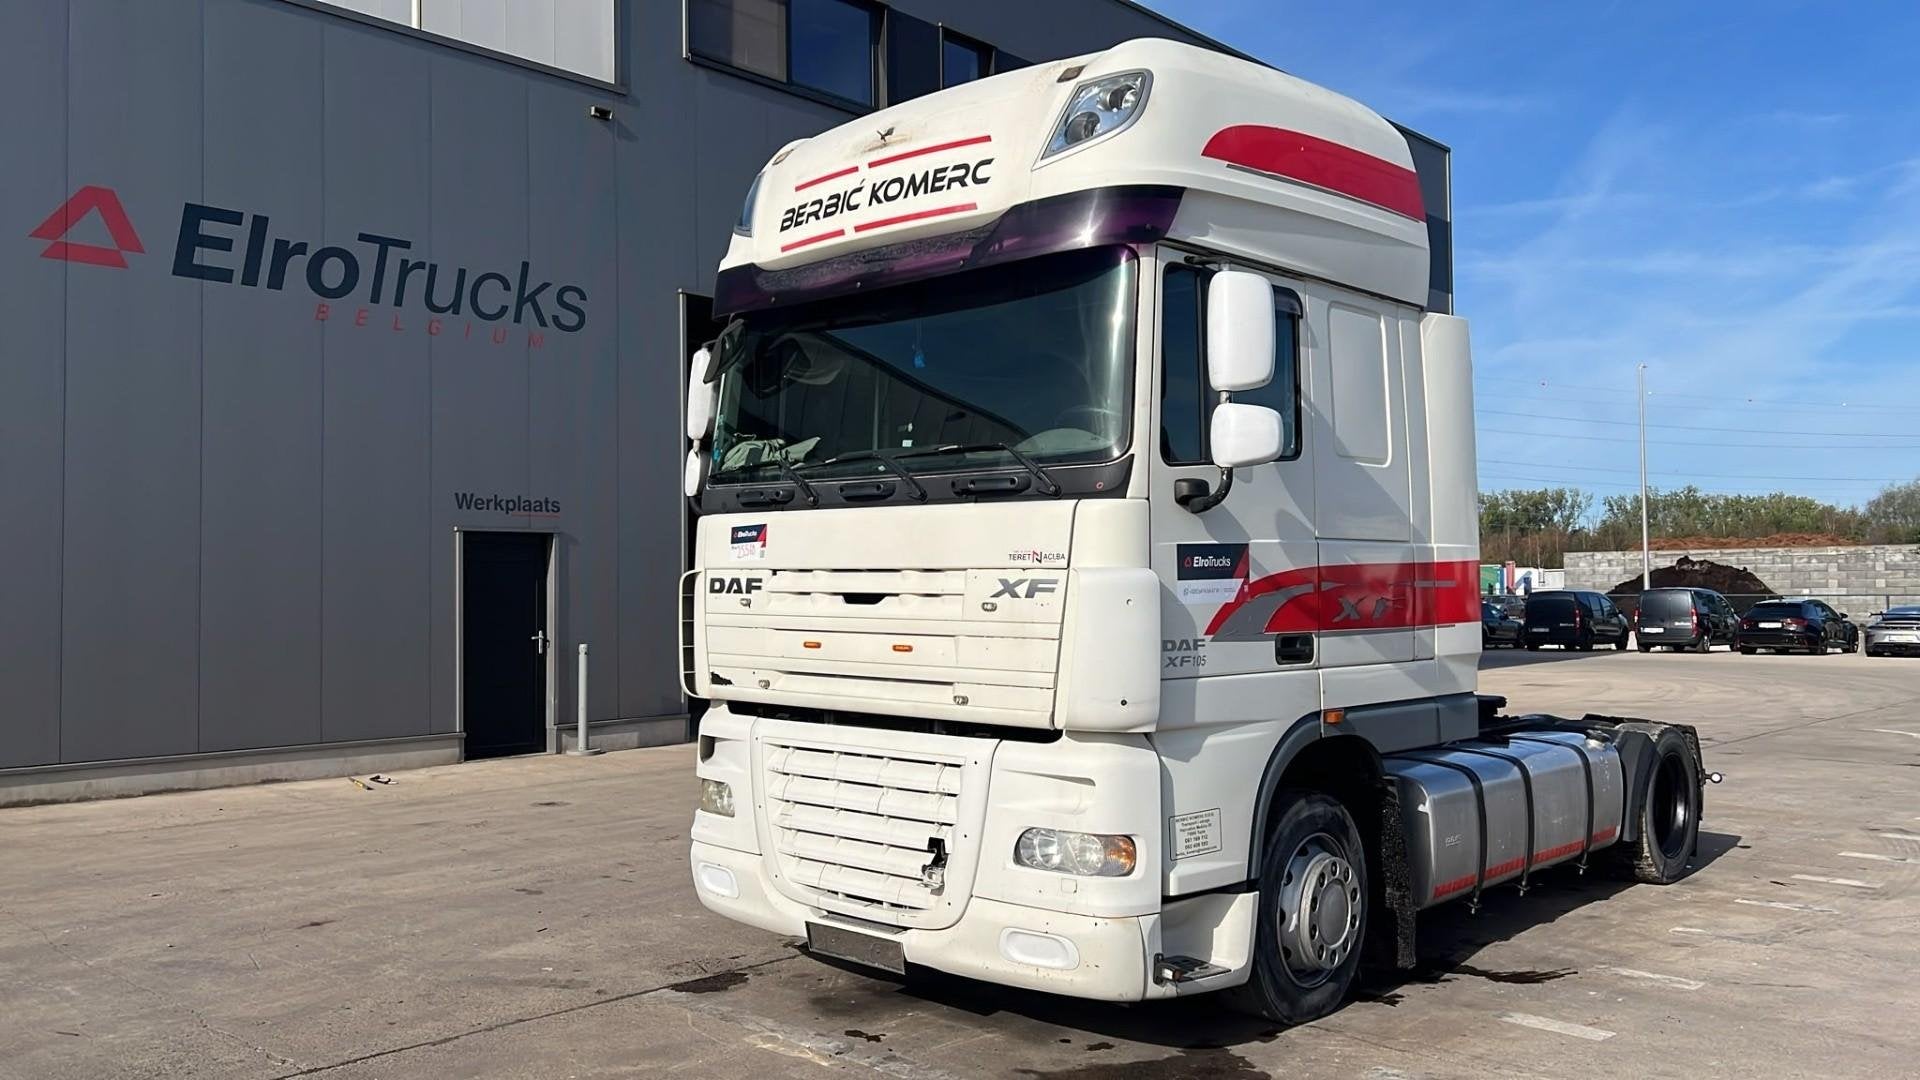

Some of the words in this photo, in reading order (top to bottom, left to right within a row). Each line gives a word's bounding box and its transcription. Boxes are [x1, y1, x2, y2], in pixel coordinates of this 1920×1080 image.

[779, 178, 865, 232] BERBIĆ
[868, 157, 994, 206] KOMERC
[171, 202, 588, 332] ElroTrucks
[314, 303, 545, 349] BELGIUM
[454, 492, 561, 515] Werkplaats
[1192, 556, 1231, 568] ElroTrucks
[709, 577, 763, 594] DAF
[989, 578, 1059, 599] XF
[1162, 638, 1206, 651] DAF
